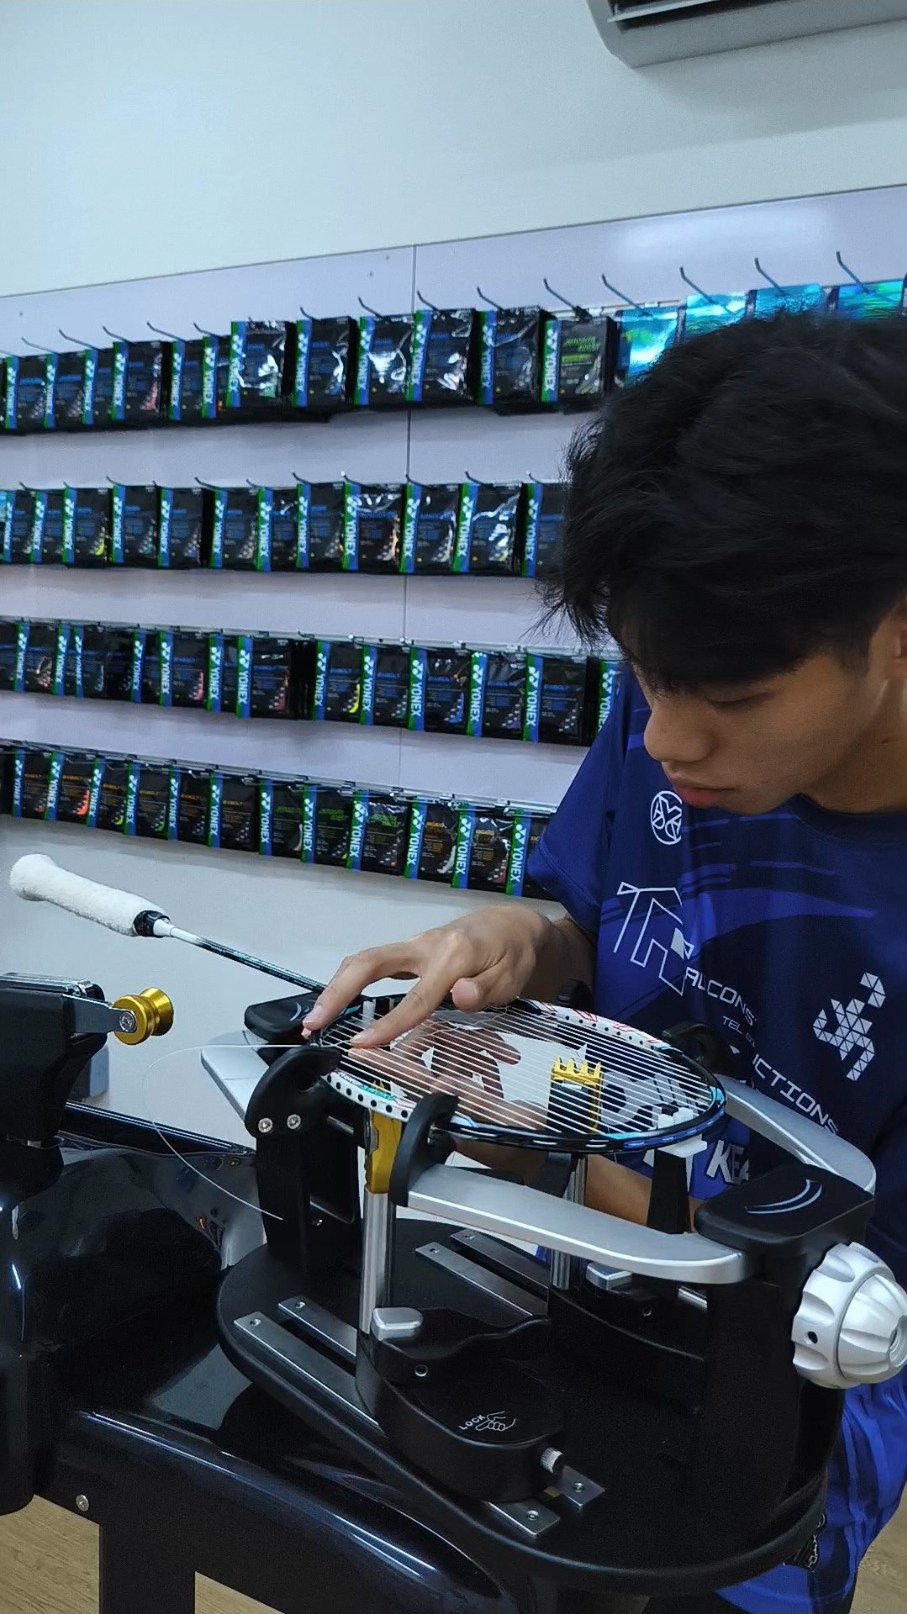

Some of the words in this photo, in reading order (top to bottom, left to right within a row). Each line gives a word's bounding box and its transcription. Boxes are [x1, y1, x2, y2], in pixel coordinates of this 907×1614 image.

[258, 523, 270, 557] YONEX
[298, 519, 307, 554] YONEX
[344, 520, 357, 556] YONEX
[402, 521, 415, 558] YONEX
[456, 523, 470, 557] YONEX
[525, 523, 537, 560] YONEX
[161, 662, 170, 695] YONEX
[209, 667, 220, 700] YONEX
[237, 671, 249, 704] YONEX
[314, 674, 325, 706] YONEX
[362, 678, 373, 712] YONEX
[410, 682, 422, 717] YONEX
[470, 687, 482, 723] YONEX
[526, 690, 538, 727] YONEX
[48, 779, 59, 808] YONEX
[88, 788, 100, 817] YONEX
[126, 795, 136, 824] YONEX
[169, 798, 179, 828] YONEX
[210, 805, 221, 836] YONEX
[260, 813, 270, 844] YONEX
[303, 820, 313, 852] YONEX
[349, 825, 362, 858] YONEX
[407, 832, 420, 865] YONEX
[455, 840, 469, 875] YONEX
[511, 847, 525, 882] YONEX
[458, 1414, 486, 1430] LOCK
